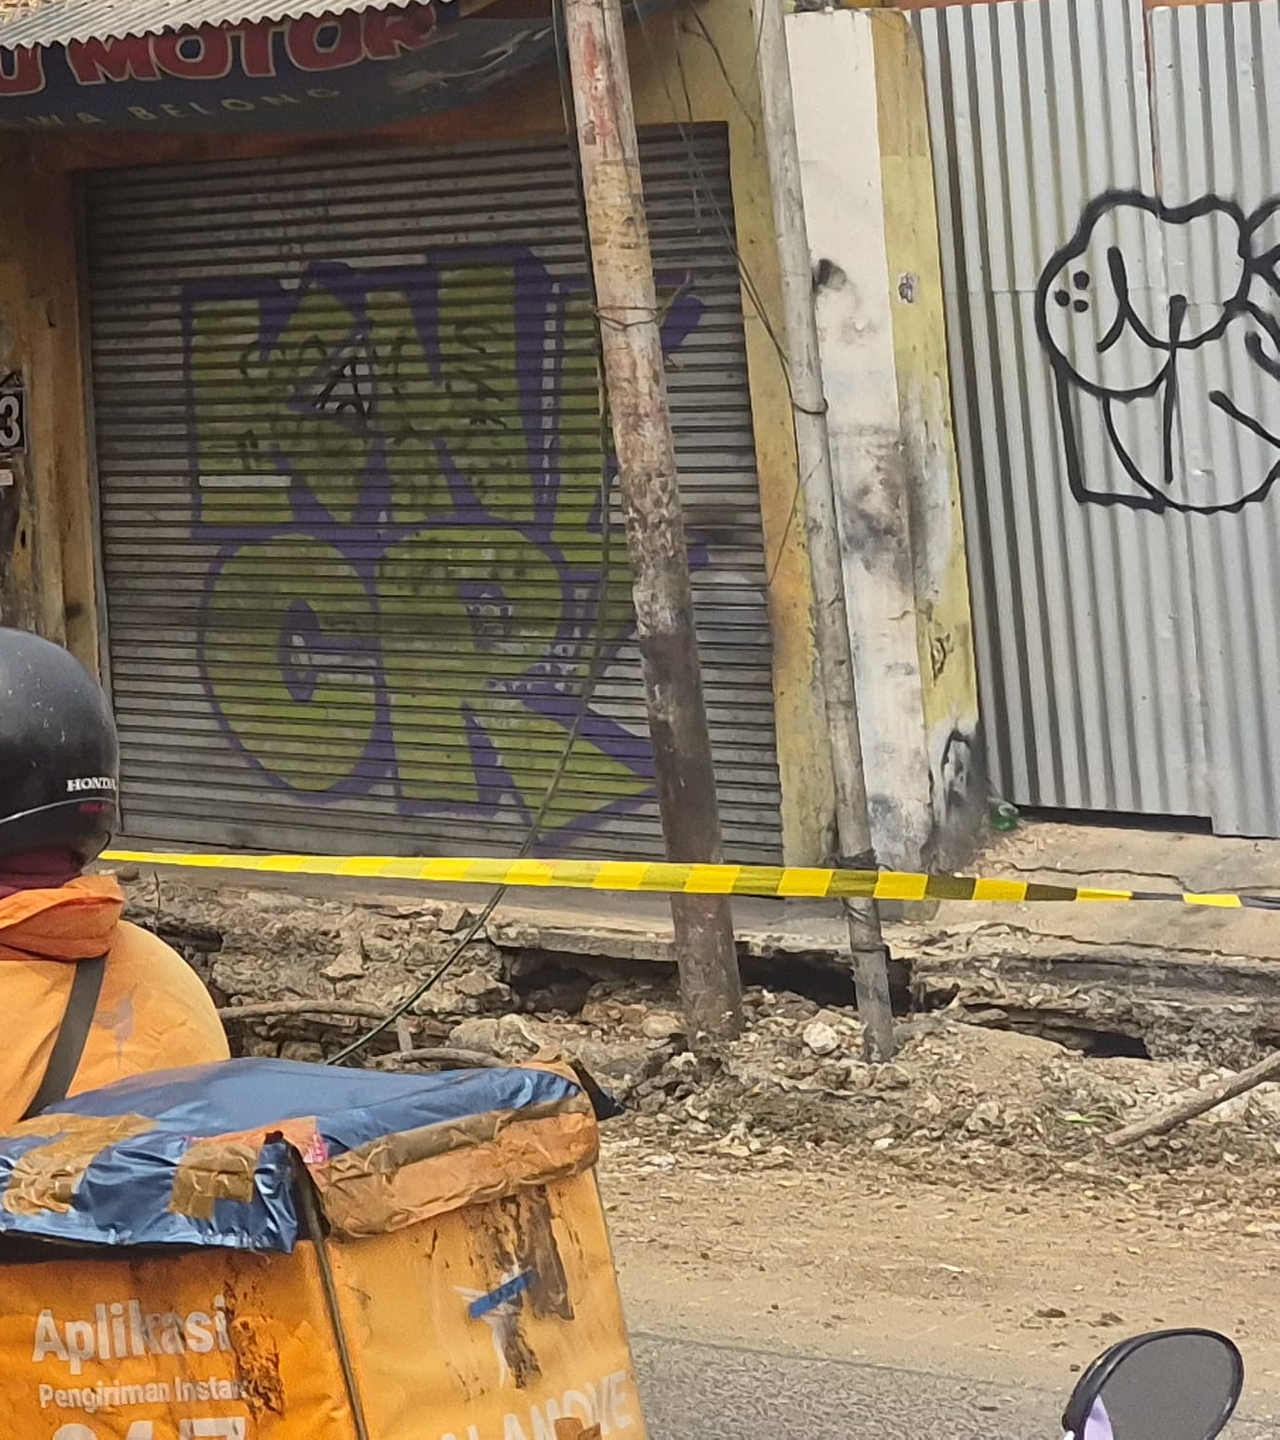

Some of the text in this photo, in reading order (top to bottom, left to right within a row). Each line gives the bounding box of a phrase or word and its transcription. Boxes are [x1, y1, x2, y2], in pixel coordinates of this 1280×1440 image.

[69, 3, 438, 85] MOTOR
[130, 87, 340, 122] BELONG
[32, 1294, 232, 1375] Aplikasi
[39, 1378, 171, 1414] Pengiriman
